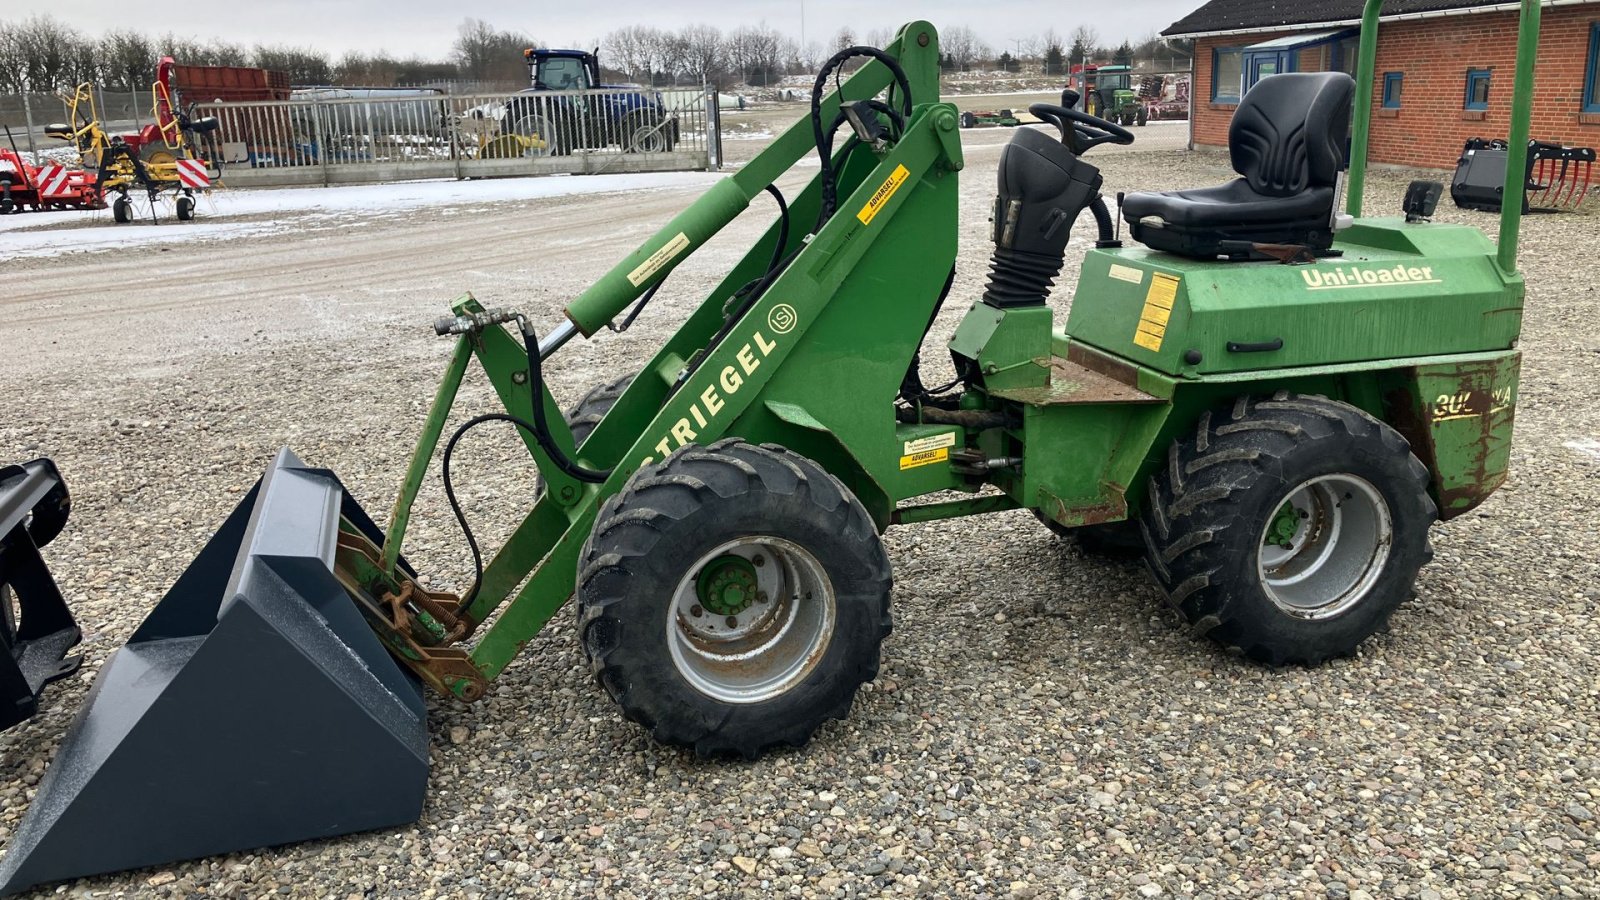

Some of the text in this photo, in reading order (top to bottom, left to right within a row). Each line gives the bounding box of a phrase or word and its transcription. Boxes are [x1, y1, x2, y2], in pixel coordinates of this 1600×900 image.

[869, 177, 895, 208] ADVARSEL!
[1301, 264, 1433, 287] Uni-loader
[640, 331, 777, 468] TRIEGEL
